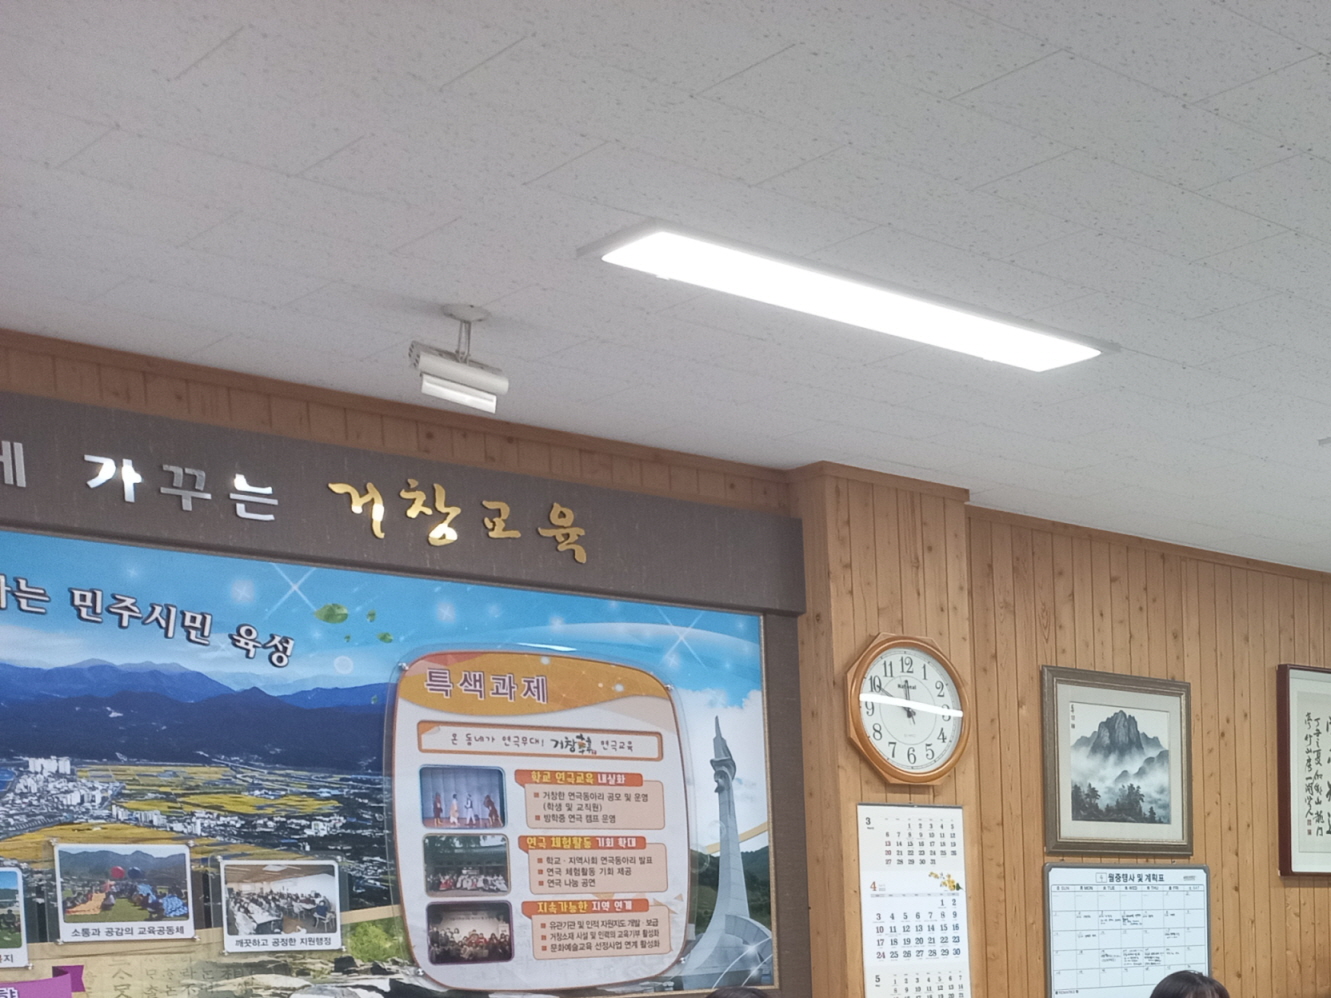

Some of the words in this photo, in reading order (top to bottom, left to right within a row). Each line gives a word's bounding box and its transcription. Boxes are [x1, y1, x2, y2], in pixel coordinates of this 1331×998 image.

[84, 454, 279, 521] 가꾸는
[328, 478, 587, 564] 거창교육
[70, 587, 213, 646] 민주시민
[228, 623, 295, 668] 육성
[883, 661, 894, 678] 11
[899, 656, 914, 673] 12
[922, 664, 928, 680] 1
[424, 668, 549, 704] 특색과제
[869, 675, 882, 693] 10
[935, 681, 944, 697] 2
[865, 701, 874, 716] 9
[873, 723, 883, 740] 8
[937, 727, 947, 743] 4
[451, 734, 458, 745] 온
[466, 734, 495, 746] 동네가
[502, 736, 545, 747] 연극무대!
[601, 740, 633, 752] 연극교육
[888, 742, 897, 758] 7
[907, 747, 917, 764] 6
[925, 743, 935, 760] 5
[531, 771, 551, 783] 학교
[556, 772, 594, 784] 연극교육
[598, 774, 625, 785] 내실화
[543, 791, 565, 801] 거창한
[568, 792, 604, 801] 연극동아리
[607, 793, 621, 801] 공모
[624, 793, 632, 802] 및
[634, 794, 648, 803] 운영
[543, 803, 562, 812] (학생
[566, 804, 572, 812] 및
[577, 804, 602, 812] 교직원)
[543, 814, 566, 823] 방학중
[568, 814, 582, 823] 연극
[586, 815, 599, 823] 캠프
[602, 815, 616, 824] 운영
[866, 817, 871, 825] 3
[527, 837, 546, 849] 연극
[551, 837, 592, 849] 체험활동
[596, 838, 614, 848] 기회
[618, 837, 636, 848] 확대
[546, 857, 561, 865] 학교
[568, 857, 598, 865] 지역사회
[601, 857, 636, 865] 연극동아리
[639, 857, 653, 865] 발표
[547, 868, 562, 877] 연극
[566, 868, 595, 876] 체험활동
[599, 868, 614, 876] 기회
[617, 868, 632, 876] 제공
[1108, 874, 1135, 883] 월중행사
[1137, 874, 1143, 883] 및
[1145, 874, 1165, 882] 계획표
[547, 879, 562, 888] 연극
[564, 879, 579, 887] 나눔
[581, 879, 596, 887] 공연
[870, 881, 877, 891] 4
[537, 901, 588, 913] 지속가능한
[592, 901, 610, 912] 지역
[614, 900, 632, 911] 연계
[903, 912, 908, 920] 5
[550, 921, 576, 930] 유관기관
[578, 921, 584, 930] 및
[586, 921, 599, 929] 인적
[628, 919, 640, 927] 개발
[646, 919, 659, 927] 보급
[903, 925, 911, 933] 12
[71, 927, 101, 938] 소통과
[105, 926, 134, 936] 공감의
[138, 925, 185, 936] 교육공동체
[550, 932, 574, 941] 거창소재
[576, 931, 588, 940] 시설
[591, 931, 597, 939] 및
[617, 930, 640, 938] 교육기부
[643, 929, 660, 938] 활성화
[236, 937, 269, 947] 깨끗하고
[272, 937, 296, 947] 공정한
[300, 936, 332, 946] 지원행정
[550, 943, 592, 953] 문화예술교육
[625, 941, 638, 950] 연계
[640, 940, 660, 949] 활성화
[953, 948, 960, 956] 30
[875, 975, 880, 983] 5
